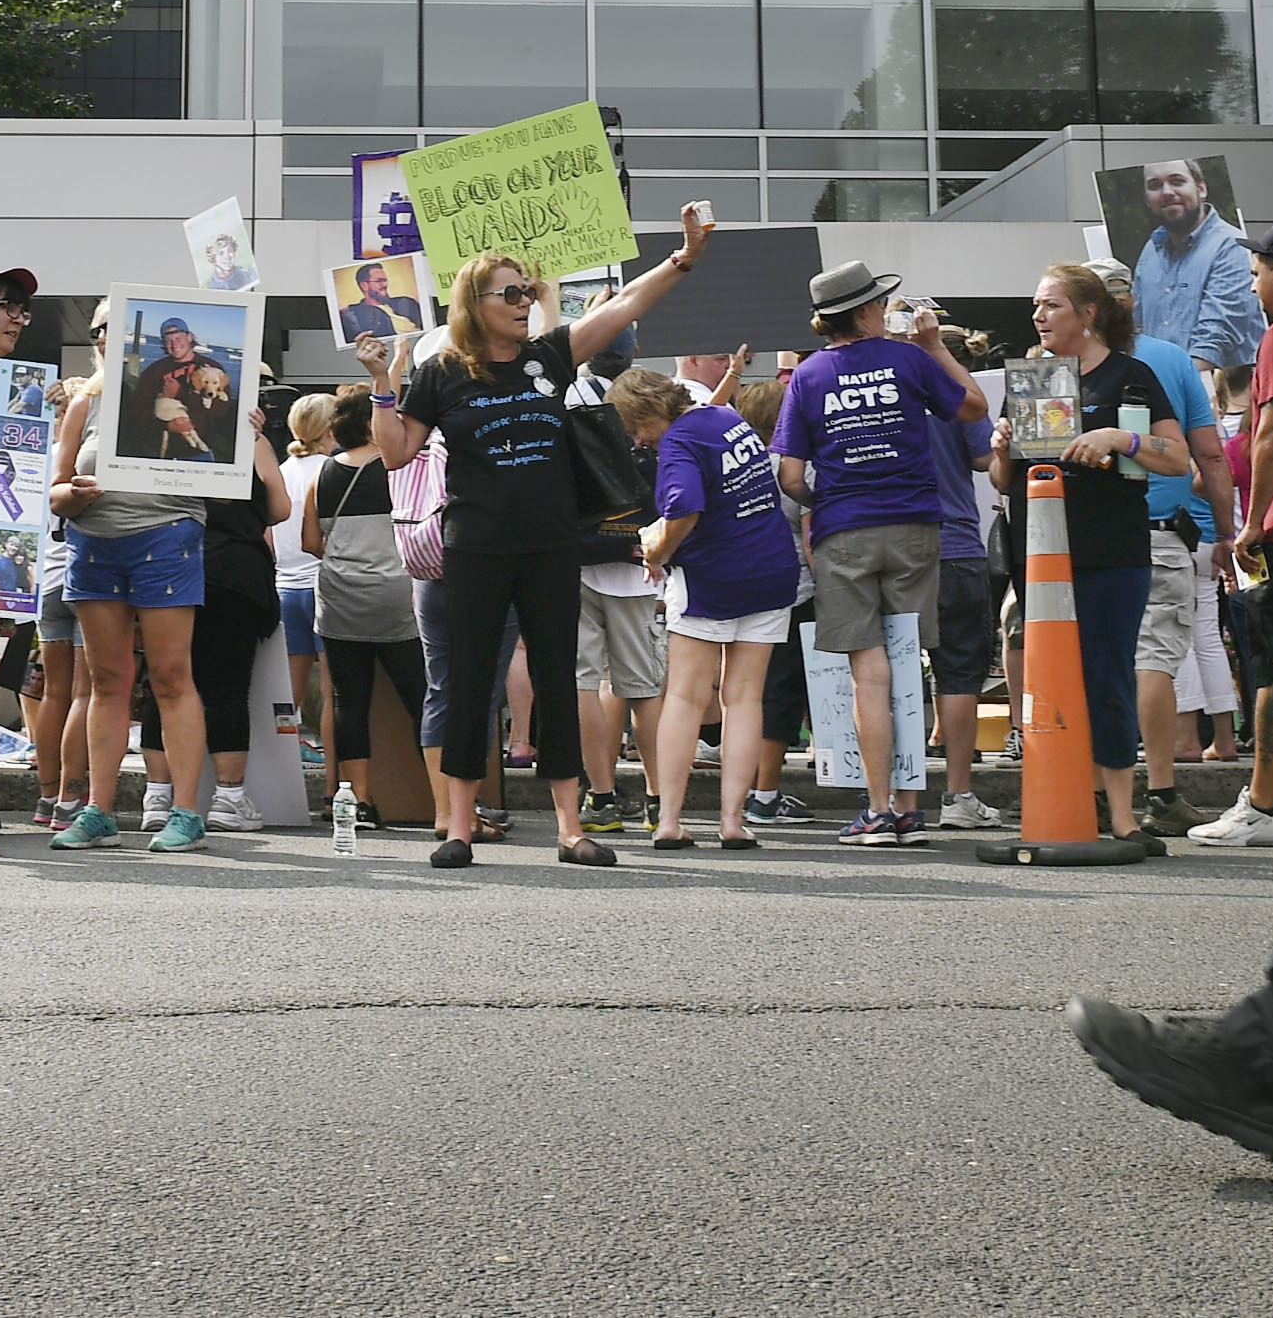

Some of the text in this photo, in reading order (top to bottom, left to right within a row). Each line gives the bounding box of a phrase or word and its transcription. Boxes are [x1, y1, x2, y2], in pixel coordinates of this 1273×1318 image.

[493, 127, 530, 154] YOU
[532, 113, 578, 143] HAVE
[418, 143, 604, 223] BLOOD ON YOUR
[451, 192, 569, 258] HANDS
[577, 229, 616, 252] MIKEY
[837, 367, 896, 386] NATICK
[823, 383, 900, 416] ACTS
[2, 423, 42, 451] 34
[830, 415, 860, 426] Community
[721, 432, 766, 475] ACTS
